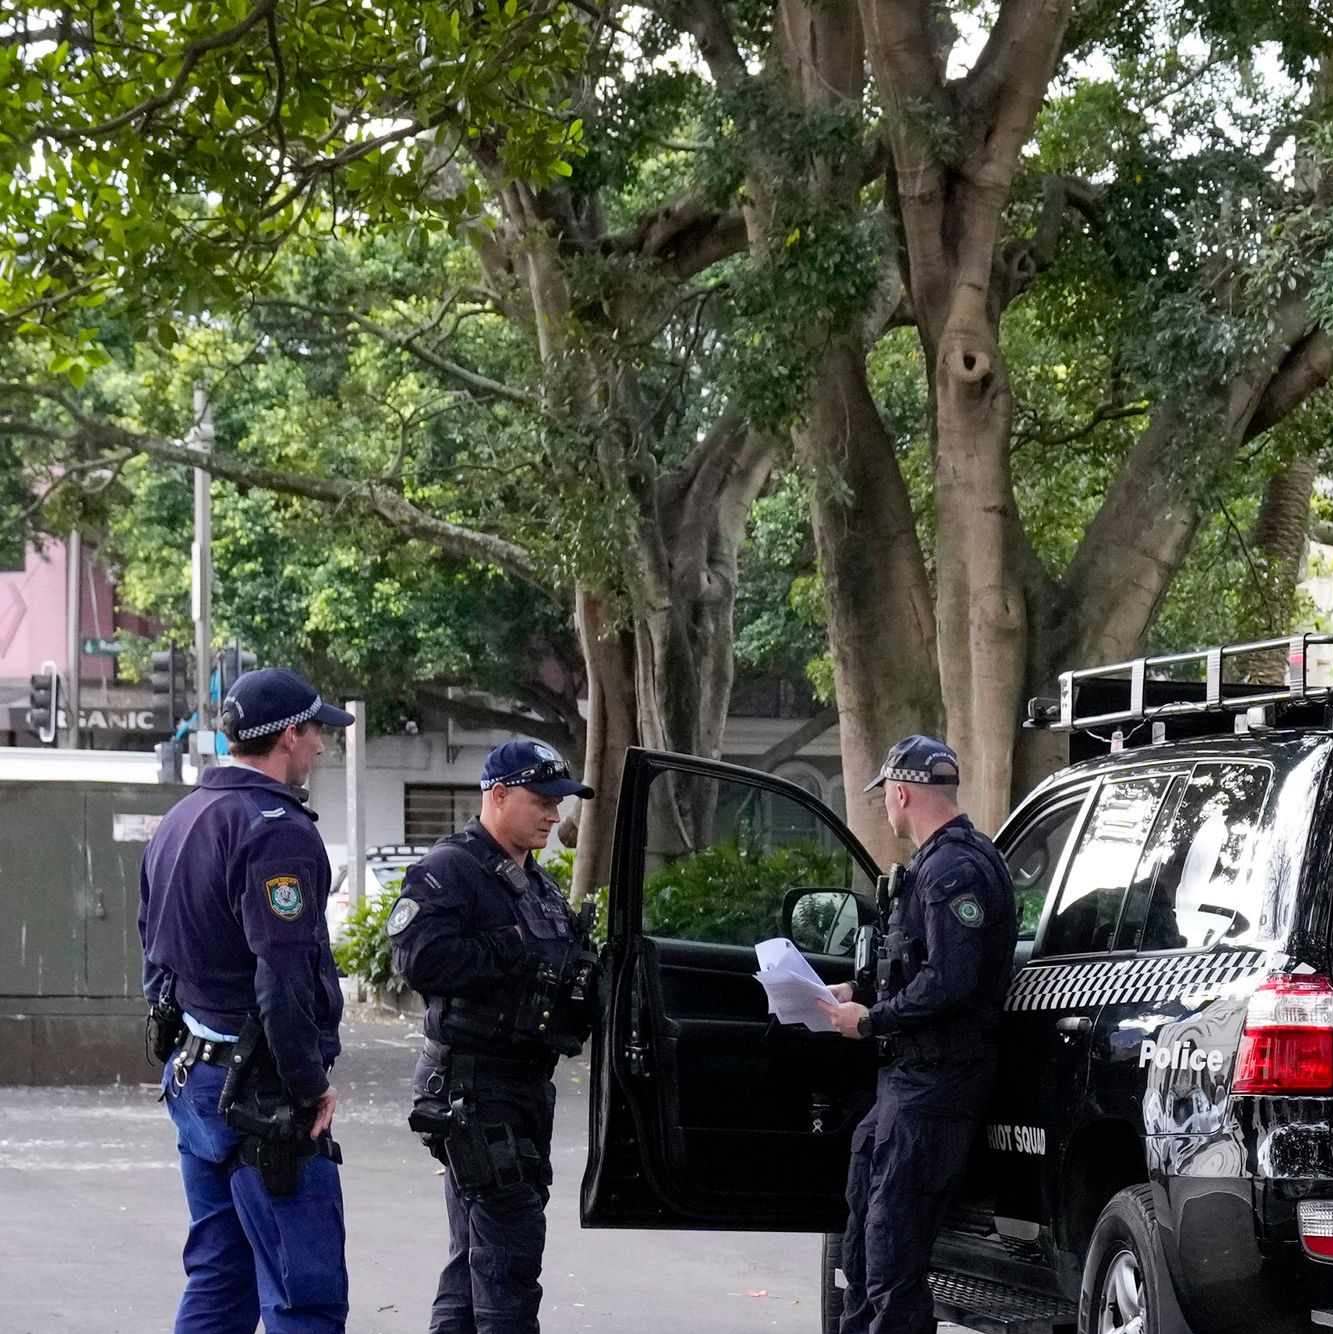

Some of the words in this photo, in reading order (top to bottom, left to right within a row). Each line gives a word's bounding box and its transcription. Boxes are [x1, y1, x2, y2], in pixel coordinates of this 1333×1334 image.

[1138, 1039, 1224, 1072] Police
[985, 1124, 1013, 1151] RIOT
[1014, 1125, 1046, 1156] SQUAD
